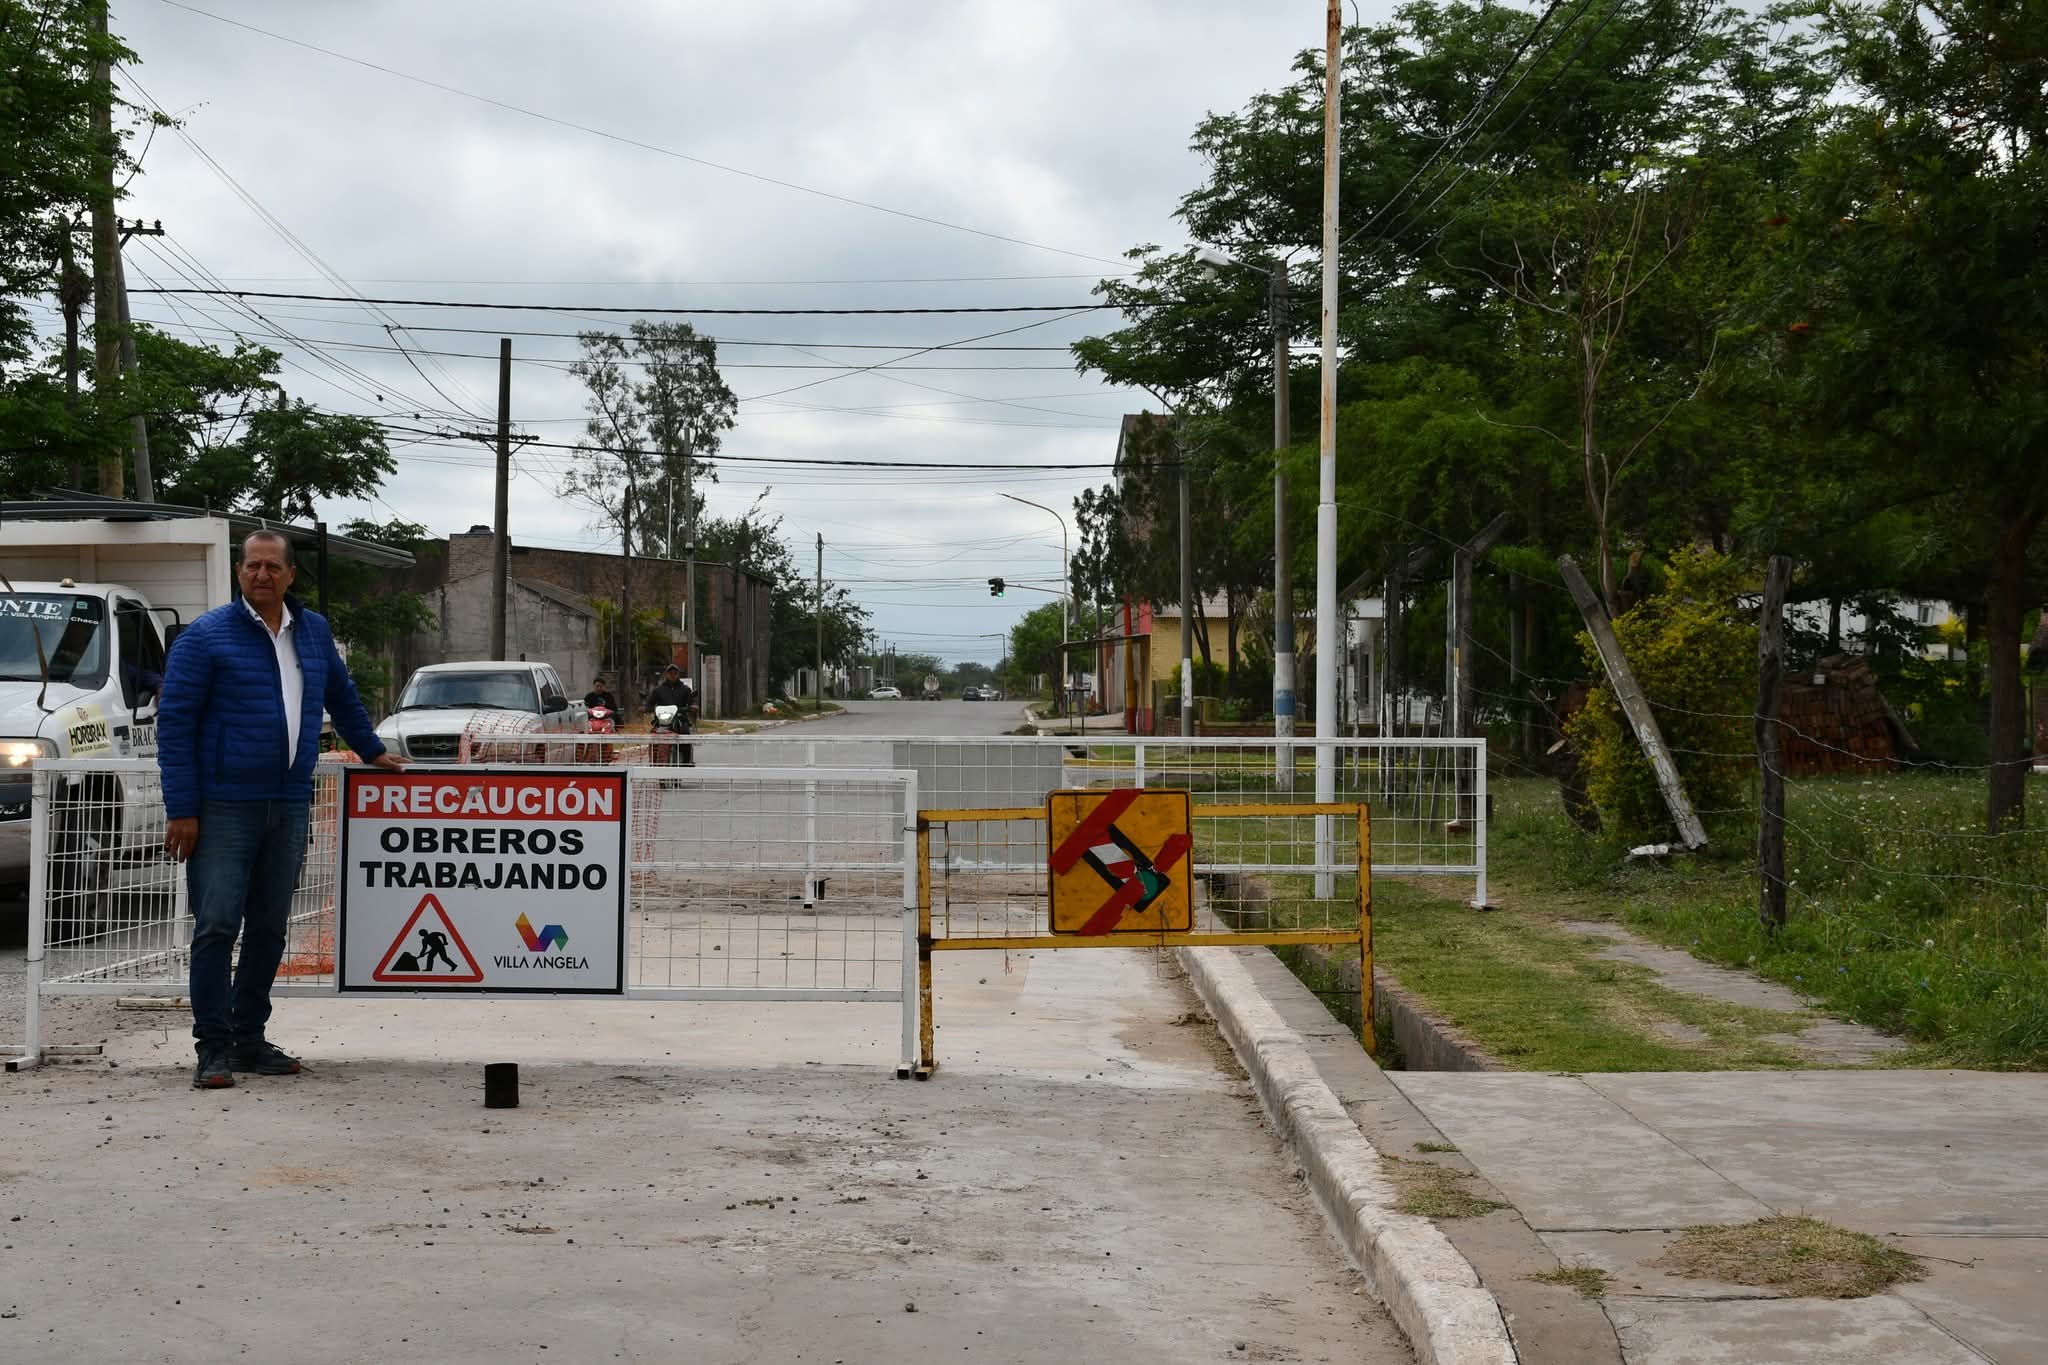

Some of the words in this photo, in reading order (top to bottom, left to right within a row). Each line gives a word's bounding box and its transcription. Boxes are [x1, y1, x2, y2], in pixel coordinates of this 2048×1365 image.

[0, 600, 62, 616] NTE
[31, 612, 62, 620] Angela
[70, 616, 99, 625] Chaco
[68, 722, 108, 747] HORBRAX
[356, 781, 613, 816] PRECAUCIÓN
[380, 826, 584, 856] OBREROS
[359, 861, 608, 890] TRABAJANDO
[493, 956, 530, 969] VILLA
[533, 956, 590, 970] ANGELA
